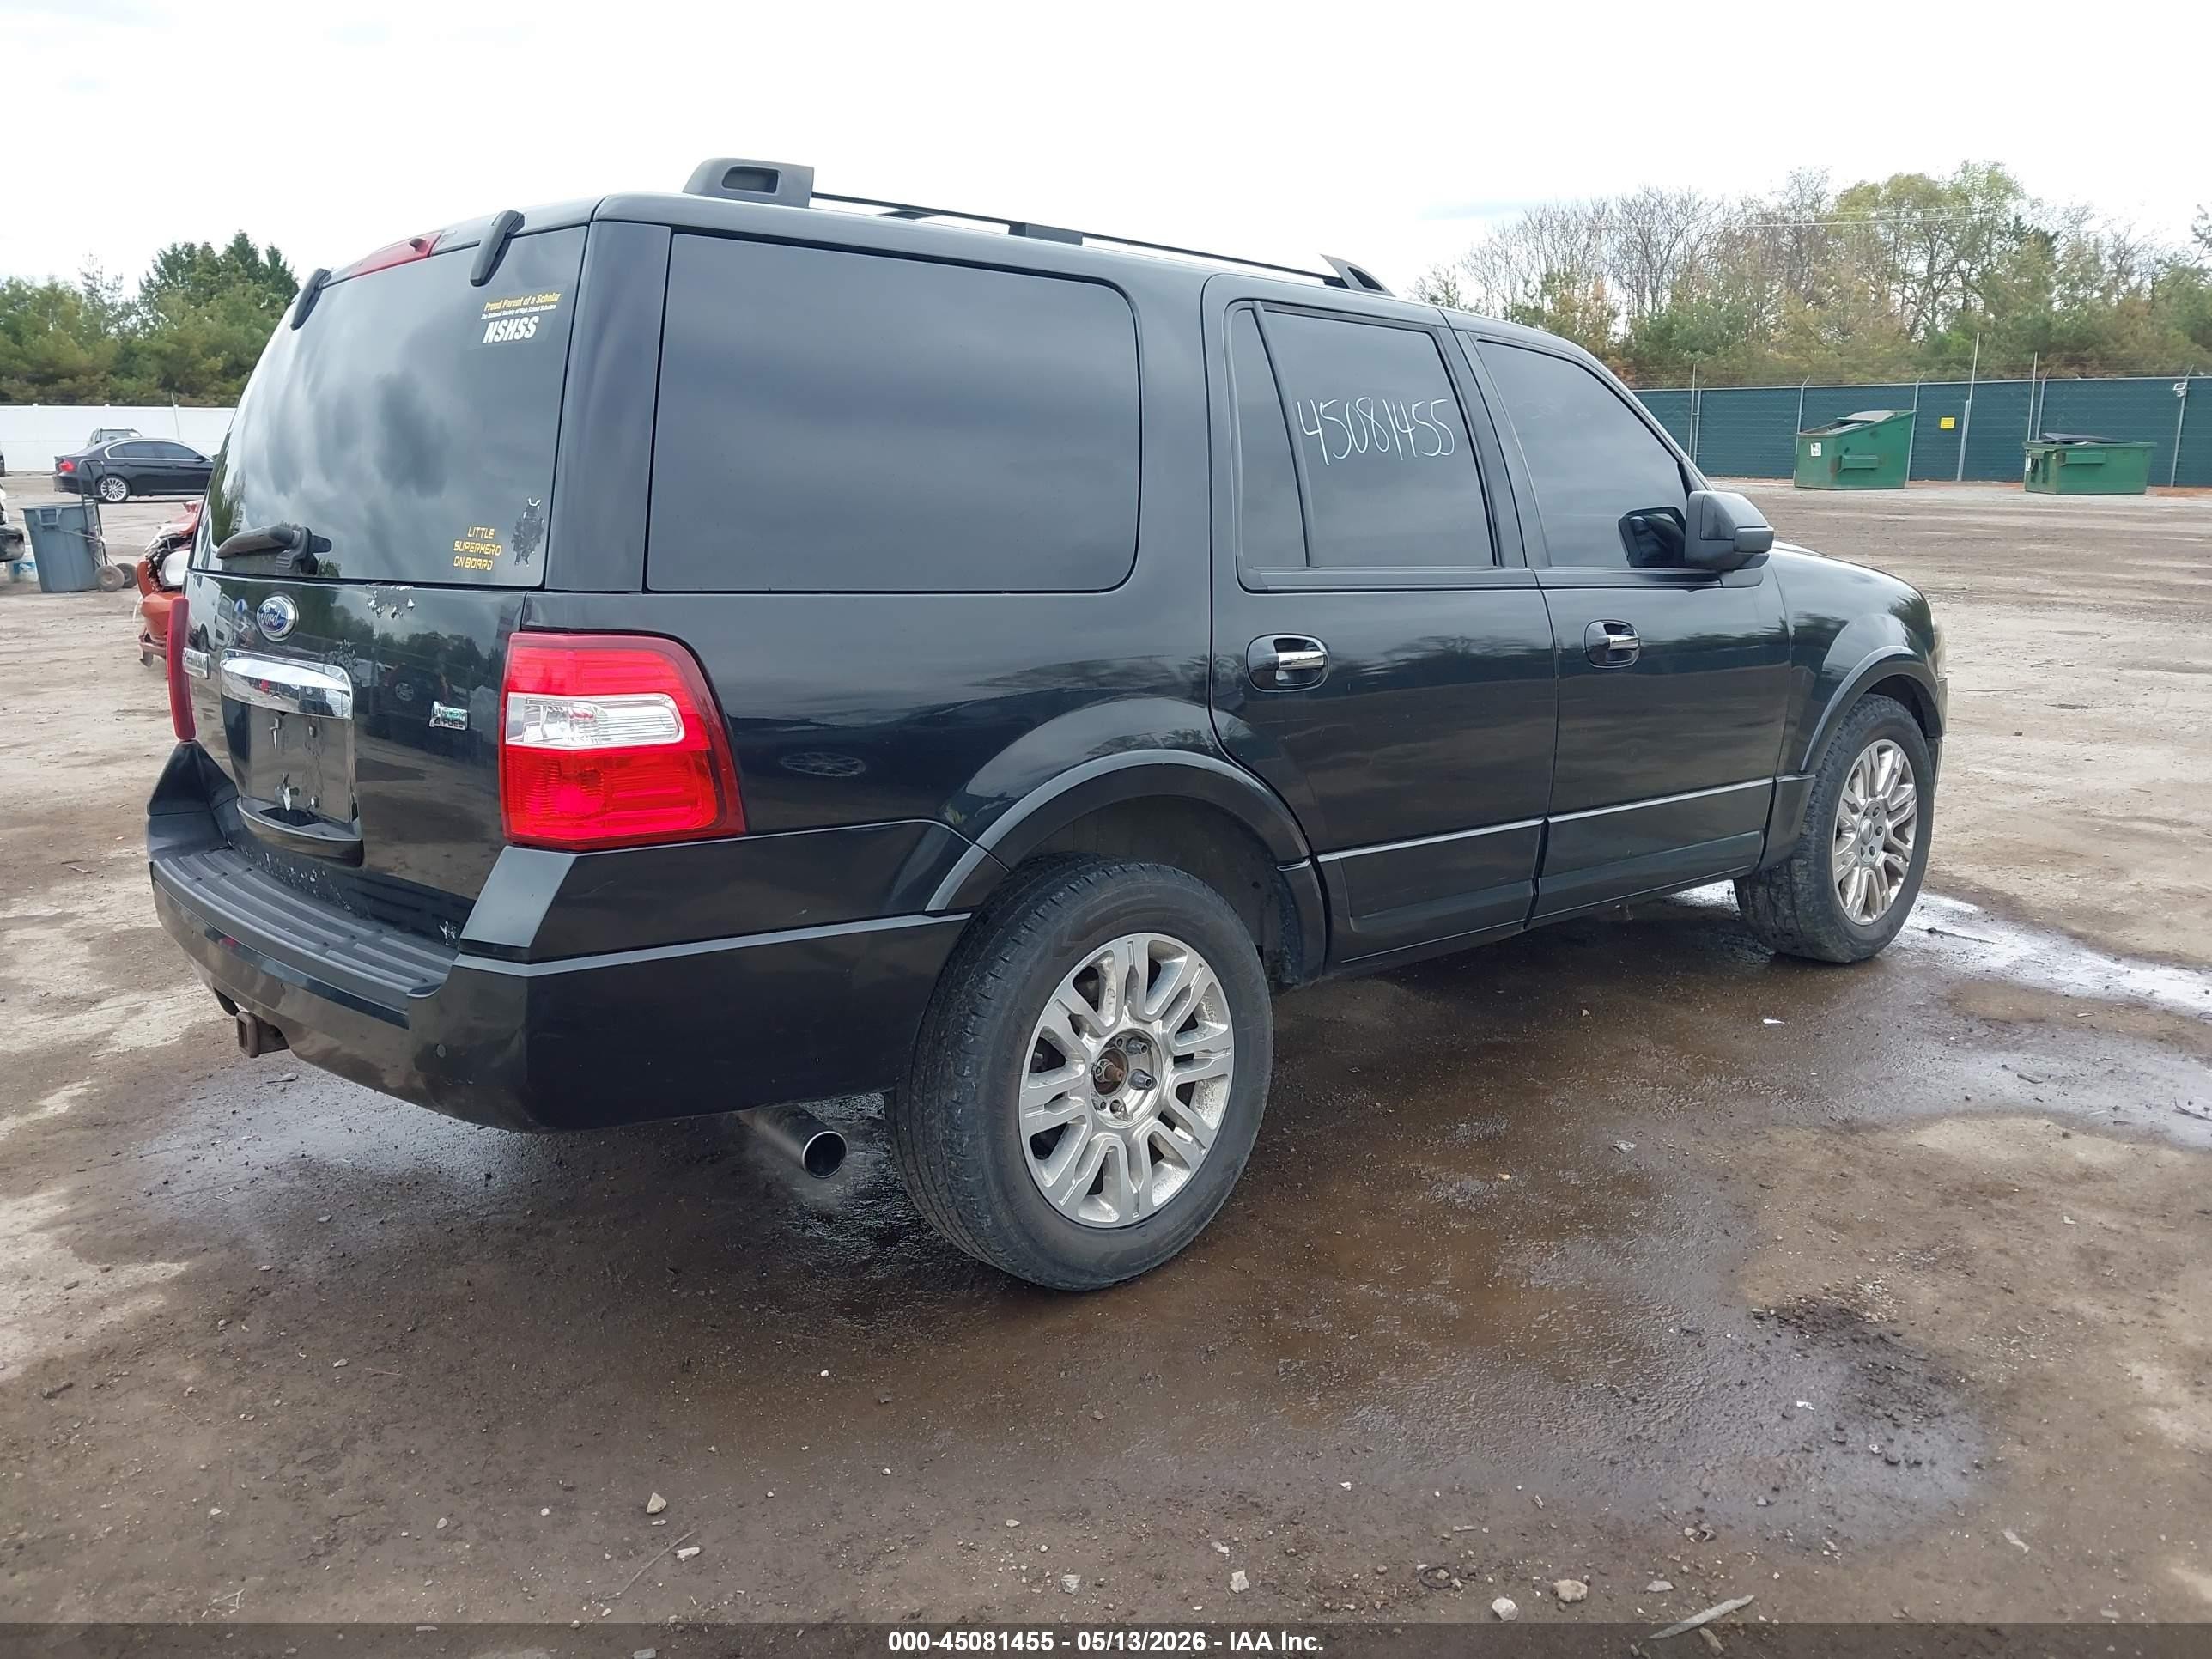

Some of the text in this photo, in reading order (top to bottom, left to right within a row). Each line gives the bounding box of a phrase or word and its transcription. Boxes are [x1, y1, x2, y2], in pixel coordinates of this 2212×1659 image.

[484, 301, 502, 311] Proud
[502, 298, 523, 308] Parent
[536, 292, 561, 303] Scholar
[482, 315, 539, 344] NSHSS
[1297, 397, 1455, 466] 45081455
[467, 526, 495, 539] LITTLE
[453, 540, 502, 556] SUPERHERO
[453, 556, 494, 571] ON BOARD
[259, 602, 282, 627] Ford
